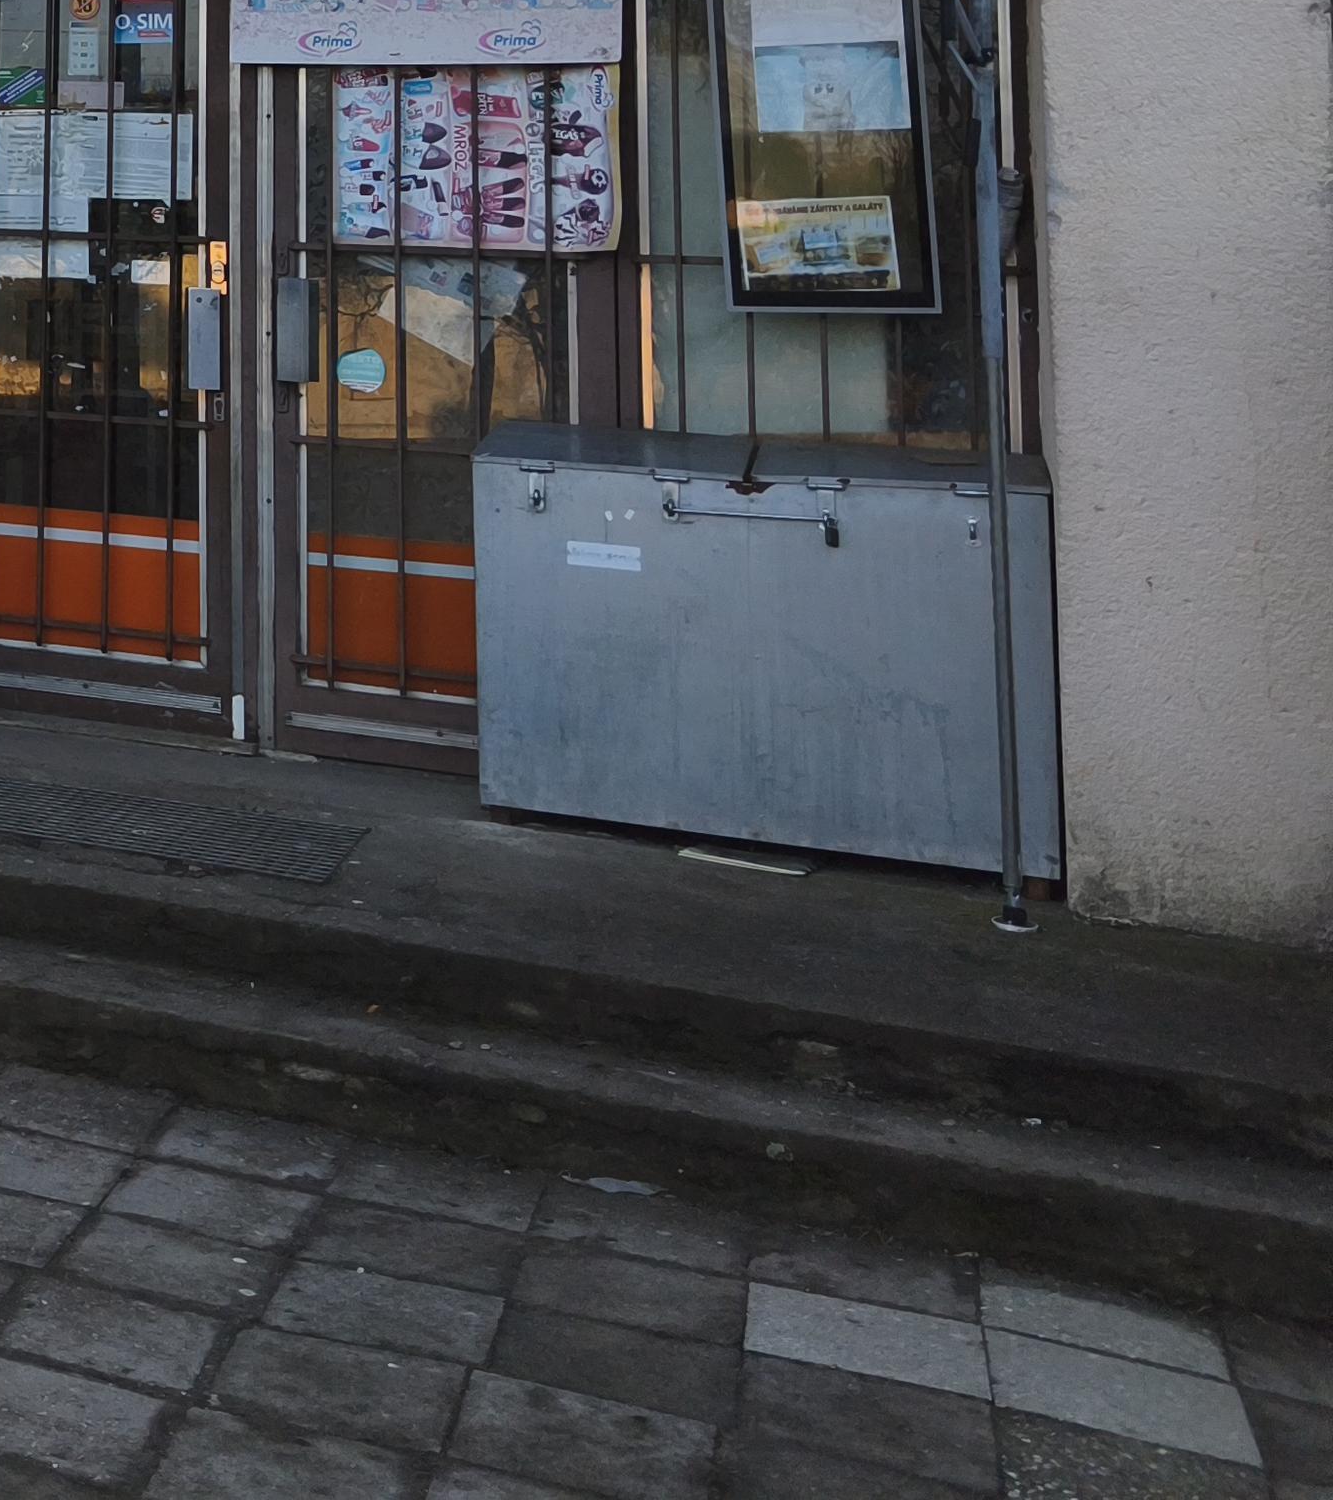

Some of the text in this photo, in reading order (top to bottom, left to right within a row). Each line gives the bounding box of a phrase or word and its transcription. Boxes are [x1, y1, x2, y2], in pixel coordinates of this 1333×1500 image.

[137, 13, 173, 29] SIM
[312, 35, 352, 48] Prima
[494, 33, 537, 47] Prima
